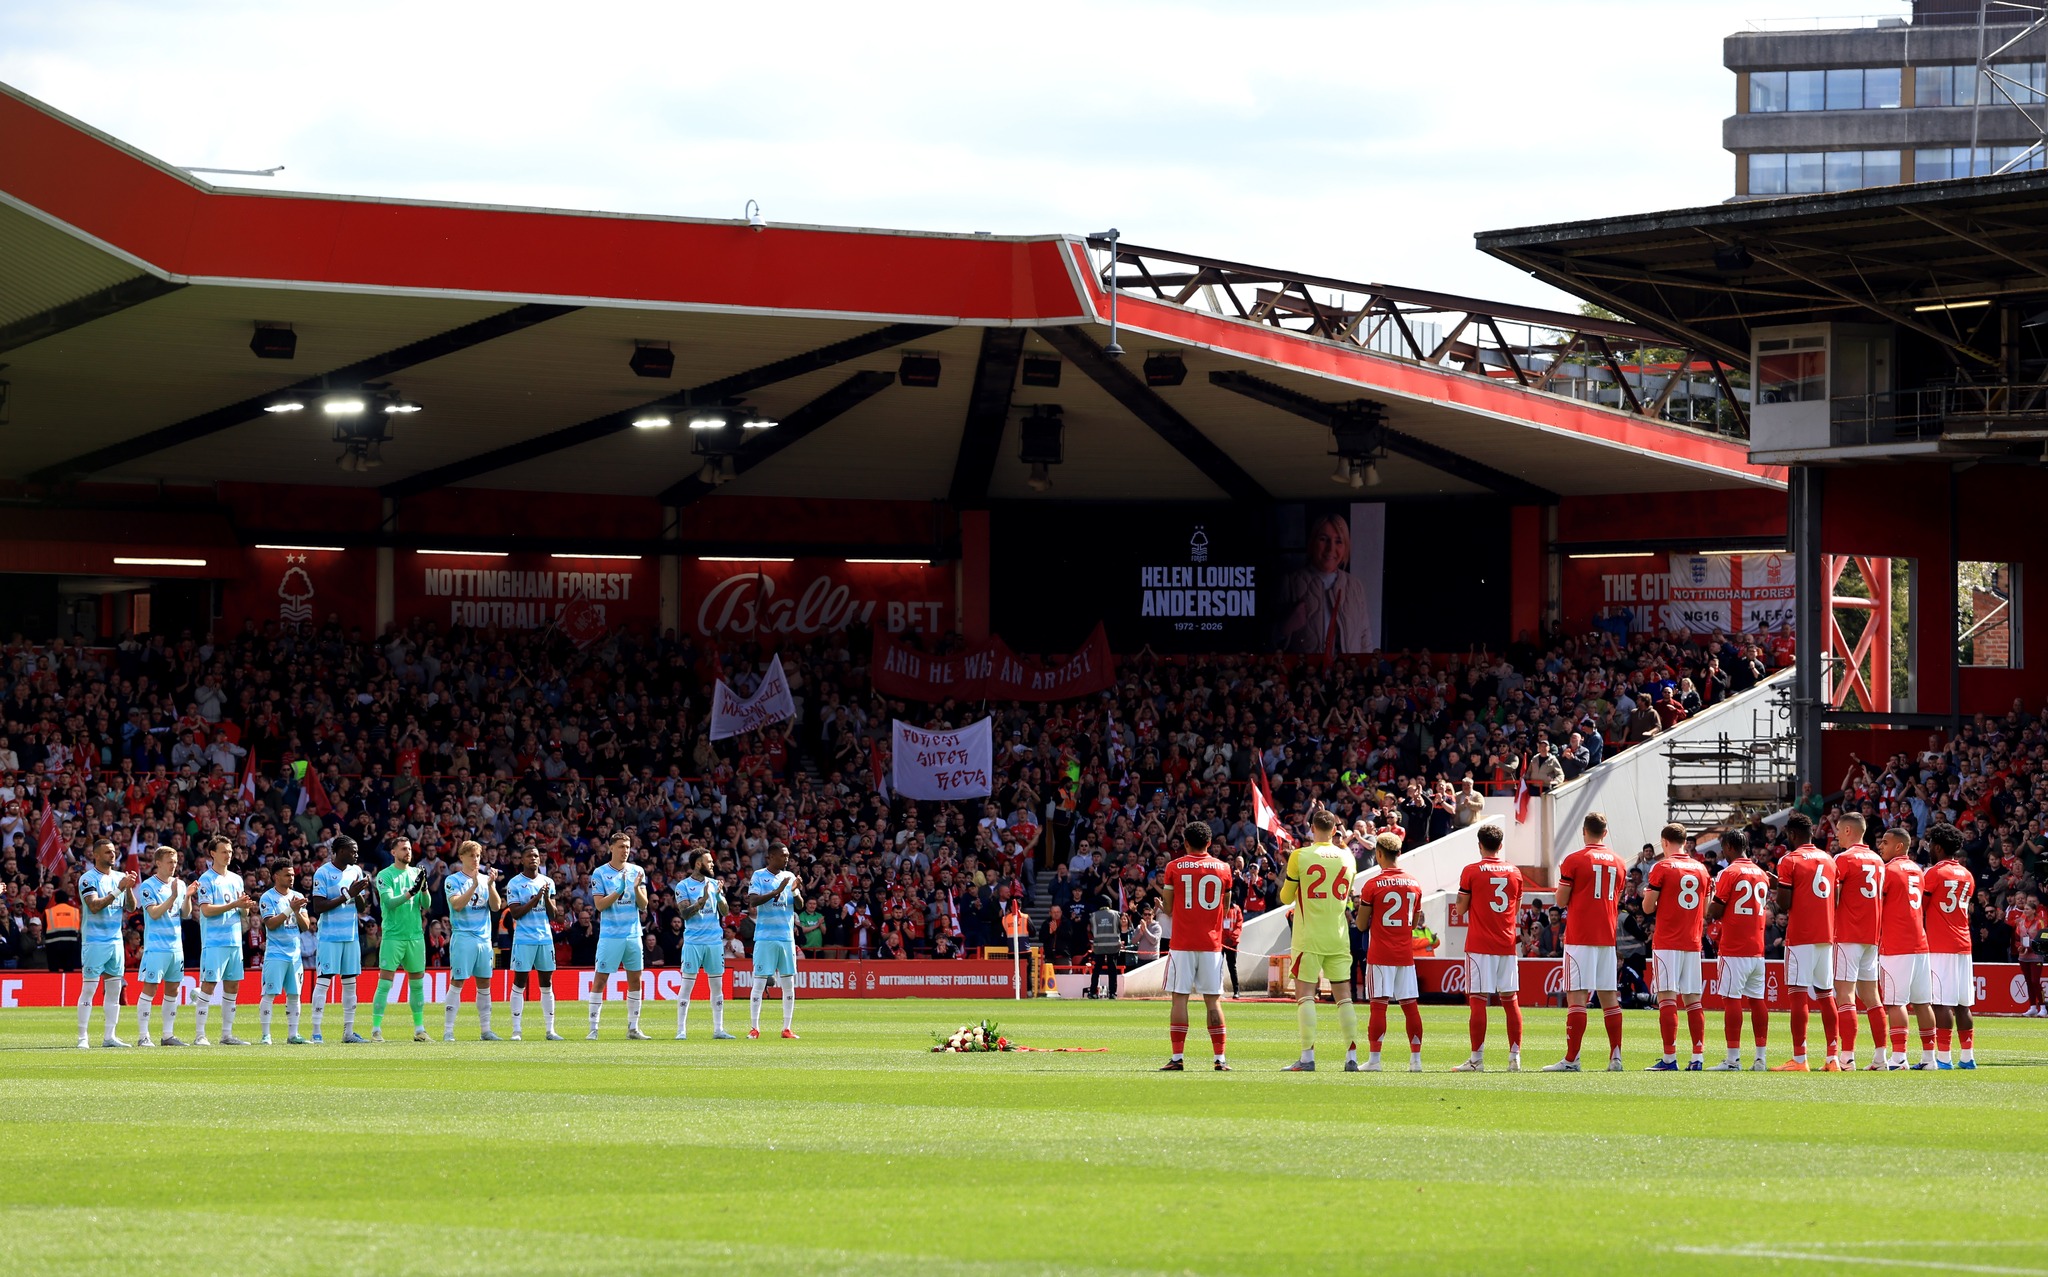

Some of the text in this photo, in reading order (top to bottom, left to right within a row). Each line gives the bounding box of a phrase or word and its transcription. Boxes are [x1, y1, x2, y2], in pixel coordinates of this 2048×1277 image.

[424, 568, 633, 600] NOTTINGHAM FOREST
[1141, 566, 1256, 587] HELEN LOUISE
[1601, 573, 1670, 602] THE CIT
[1141, 590, 1256, 617] ANDERSON
[1673, 589, 1751, 599] NOTTINGHAM
[451, 601, 547, 629] FOOTBALL
[887, 601, 944, 633] BET
[1174, 622, 1194, 631] 1972
[1200, 622, 1223, 631] 2026
[1684, 611, 1719, 621] NG16
[883, 645, 921, 679] AND
[928, 662, 954, 684] HE
[1000, 656, 1024, 686] AN
[903, 729, 960, 747] FOREST
[916, 749, 968, 767] SUPER
[934, 768, 987, 791] REDS
[1176, 861, 1225, 871] GIBBS-WHITE
[1592, 852, 1615, 862] WOOD
[1181, 874, 1223, 911] 10
[1306, 863, 1349, 901] 26
[1489, 877, 1509, 913] 3
[1592, 864, 1617, 901] 11
[1677, 874, 1700, 910] 8
[1812, 864, 1831, 899] 6
[1859, 864, 1886, 900] 31
[1908, 875, 1922, 910] 5
[1382, 891, 1416, 927] 21
[1733, 879, 1768, 917] 29
[1939, 880, 1971, 915] 34
[809, 971, 844, 989] REDS!
[879, 975, 1008, 985] NOTTINGHAM FOREST FOOTBALL CLUB
